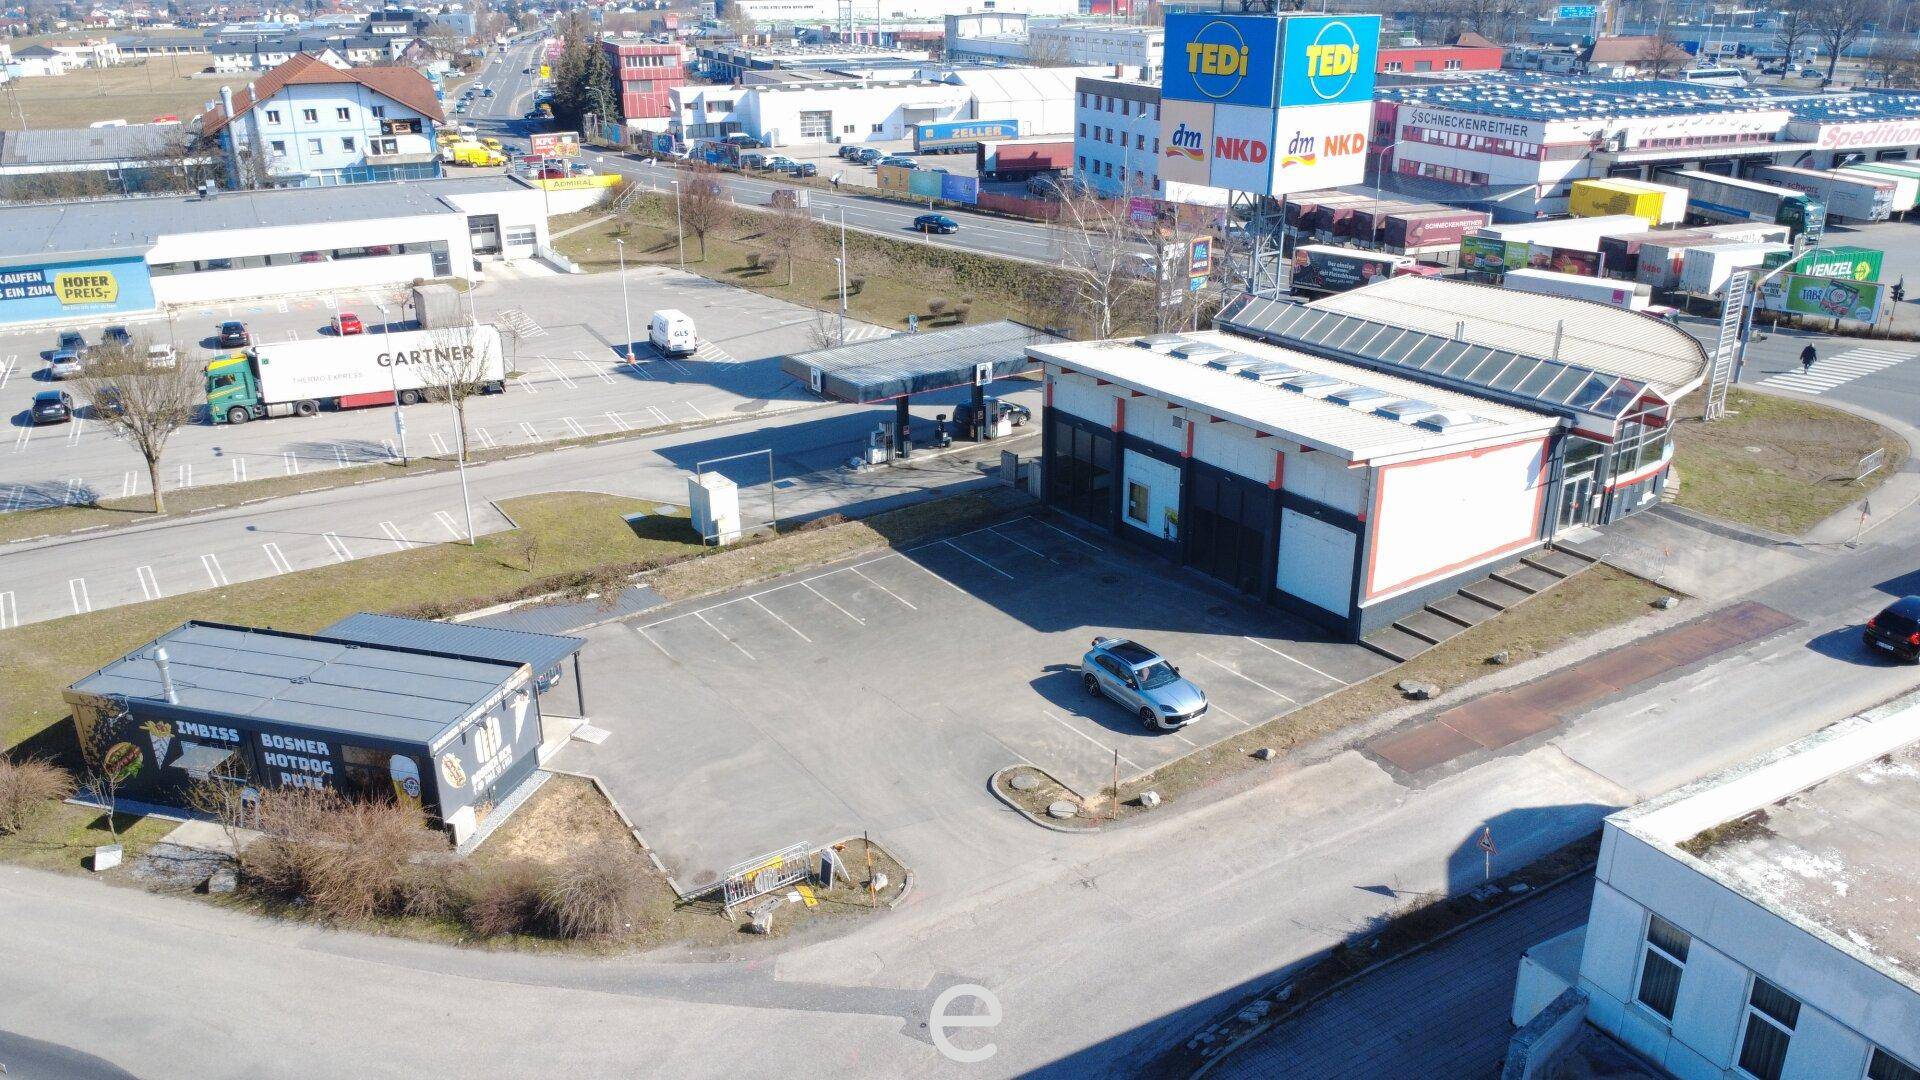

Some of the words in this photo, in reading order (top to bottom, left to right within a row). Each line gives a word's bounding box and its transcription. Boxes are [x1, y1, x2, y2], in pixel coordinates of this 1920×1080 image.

[1721, 44, 1736, 52] GLS
[1186, 43, 1249, 77] TEDi
[1306, 43, 1359, 77] TEDi
[952, 126, 1002, 138] ZELLER
[1418, 112, 1528, 137] SCHNECKENREITHER
[1172, 124, 1201, 149] dm
[1289, 130, 1314, 155] dm
[1324, 133, 1364, 157] NKD
[1822, 123, 1920, 150] Spedition
[1215, 136, 1267, 163] NKD
[553, 180, 594, 188] ADMIRAL
[1805, 261, 1852, 276] WENZEL
[6, 287, 27, 298] EIN
[29, 285, 53, 296] ZUM
[63, 276, 110, 288] HOFER
[376, 345, 475, 368] GARTNER
[292, 375, 326, 384] THERMO
[327, 372, 363, 381] EXPRESS
[176, 721, 240, 742] IMBISS
[260, 733, 330, 756] BOSNER
[264, 751, 334, 775] HOTDOG
